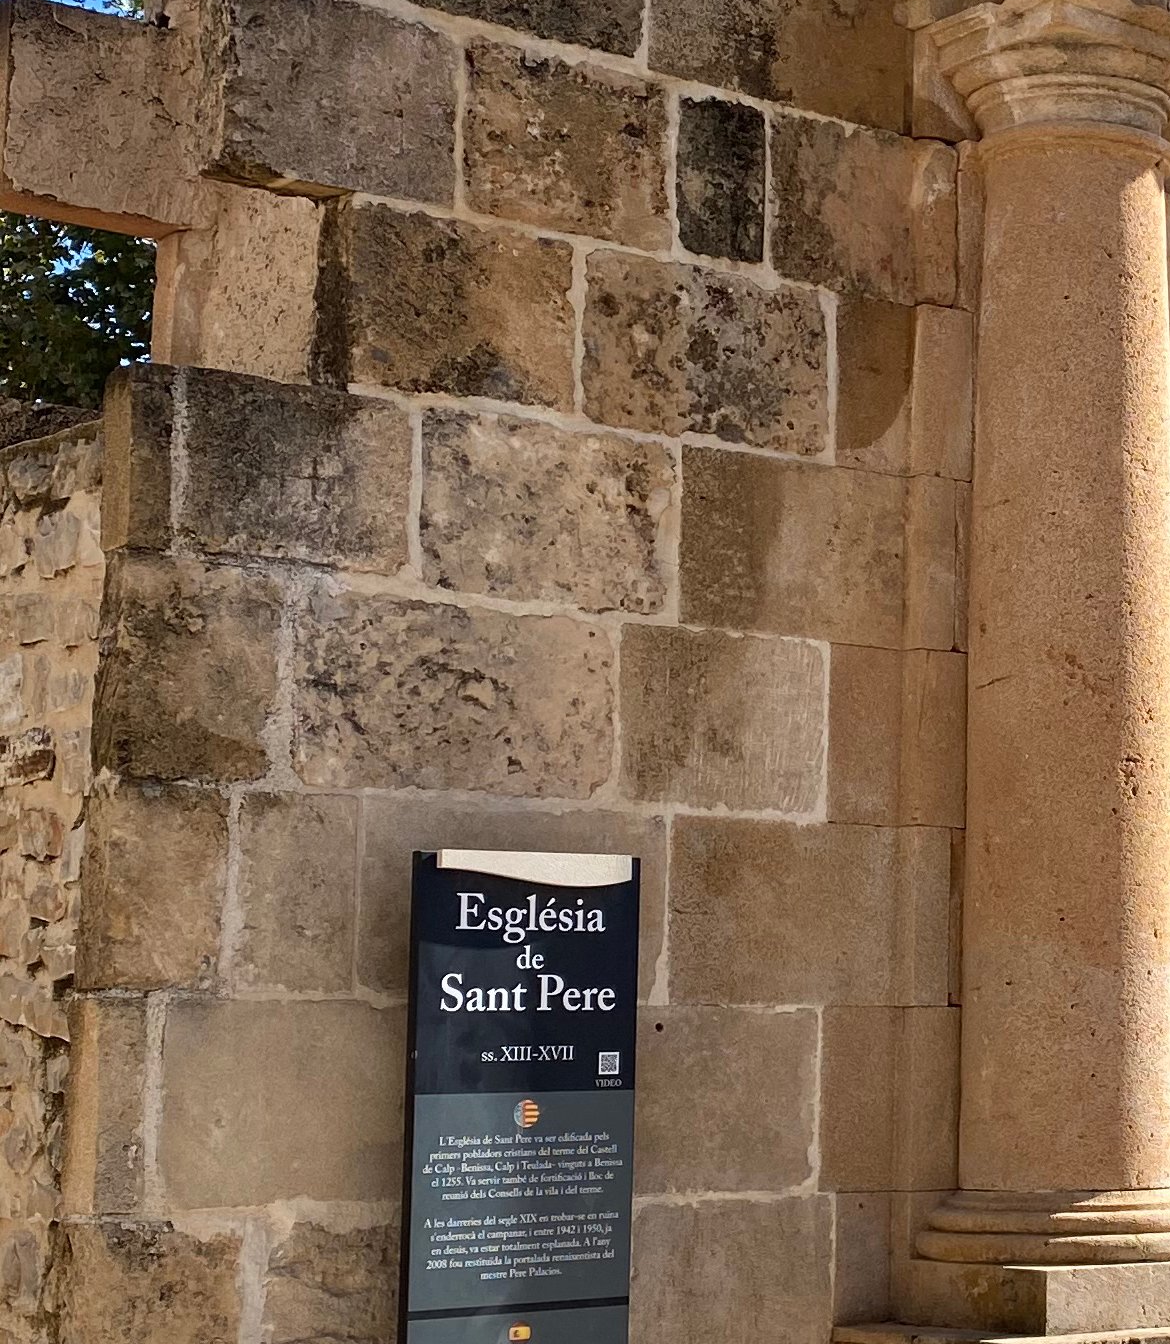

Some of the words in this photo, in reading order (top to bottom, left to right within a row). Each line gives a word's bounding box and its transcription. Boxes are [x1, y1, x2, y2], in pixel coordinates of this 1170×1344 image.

[455, 892, 606, 943] Església
[516, 945, 544, 969] de
[440, 973, 527, 1012] Sant
[536, 974, 615, 1012] Pere
[481, 1050, 497, 1062] ss.
[500, 1045, 574, 1062] XIII-XVII
[482, 1135, 493, 1145] de
[494, 1135, 513, 1144] Sant
[515, 1134, 532, 1144] Pere
[594, 1131, 609, 1144] pels
[463, 1148, 503, 1161] pobladors
[538, 1146, 551, 1156] del
[590, 1144, 617, 1154] Castell
[422, 1163, 433, 1173] de
[434, 1162, 455, 1175] Calp
[495, 1160, 515, 1173] Calp
[465, 1176, 477, 1186] Va
[478, 1175, 501, 1185] servir
[470, 1189, 487, 1199] dels
[488, 1187, 523, 1198] Consells
[524, 1187, 534, 1196] de
[424, 1219, 432, 1229] A
[434, 1219, 445, 1228] les
[483, 1215, 496, 1225] del
[519, 1213, 537, 1223] XIX
[533, 1227, 554, 1236] entre
[557, 1225, 576, 1235] 1942
[425, 1258, 448, 1269] 2008
[509, 1268, 527, 1278] Pere
